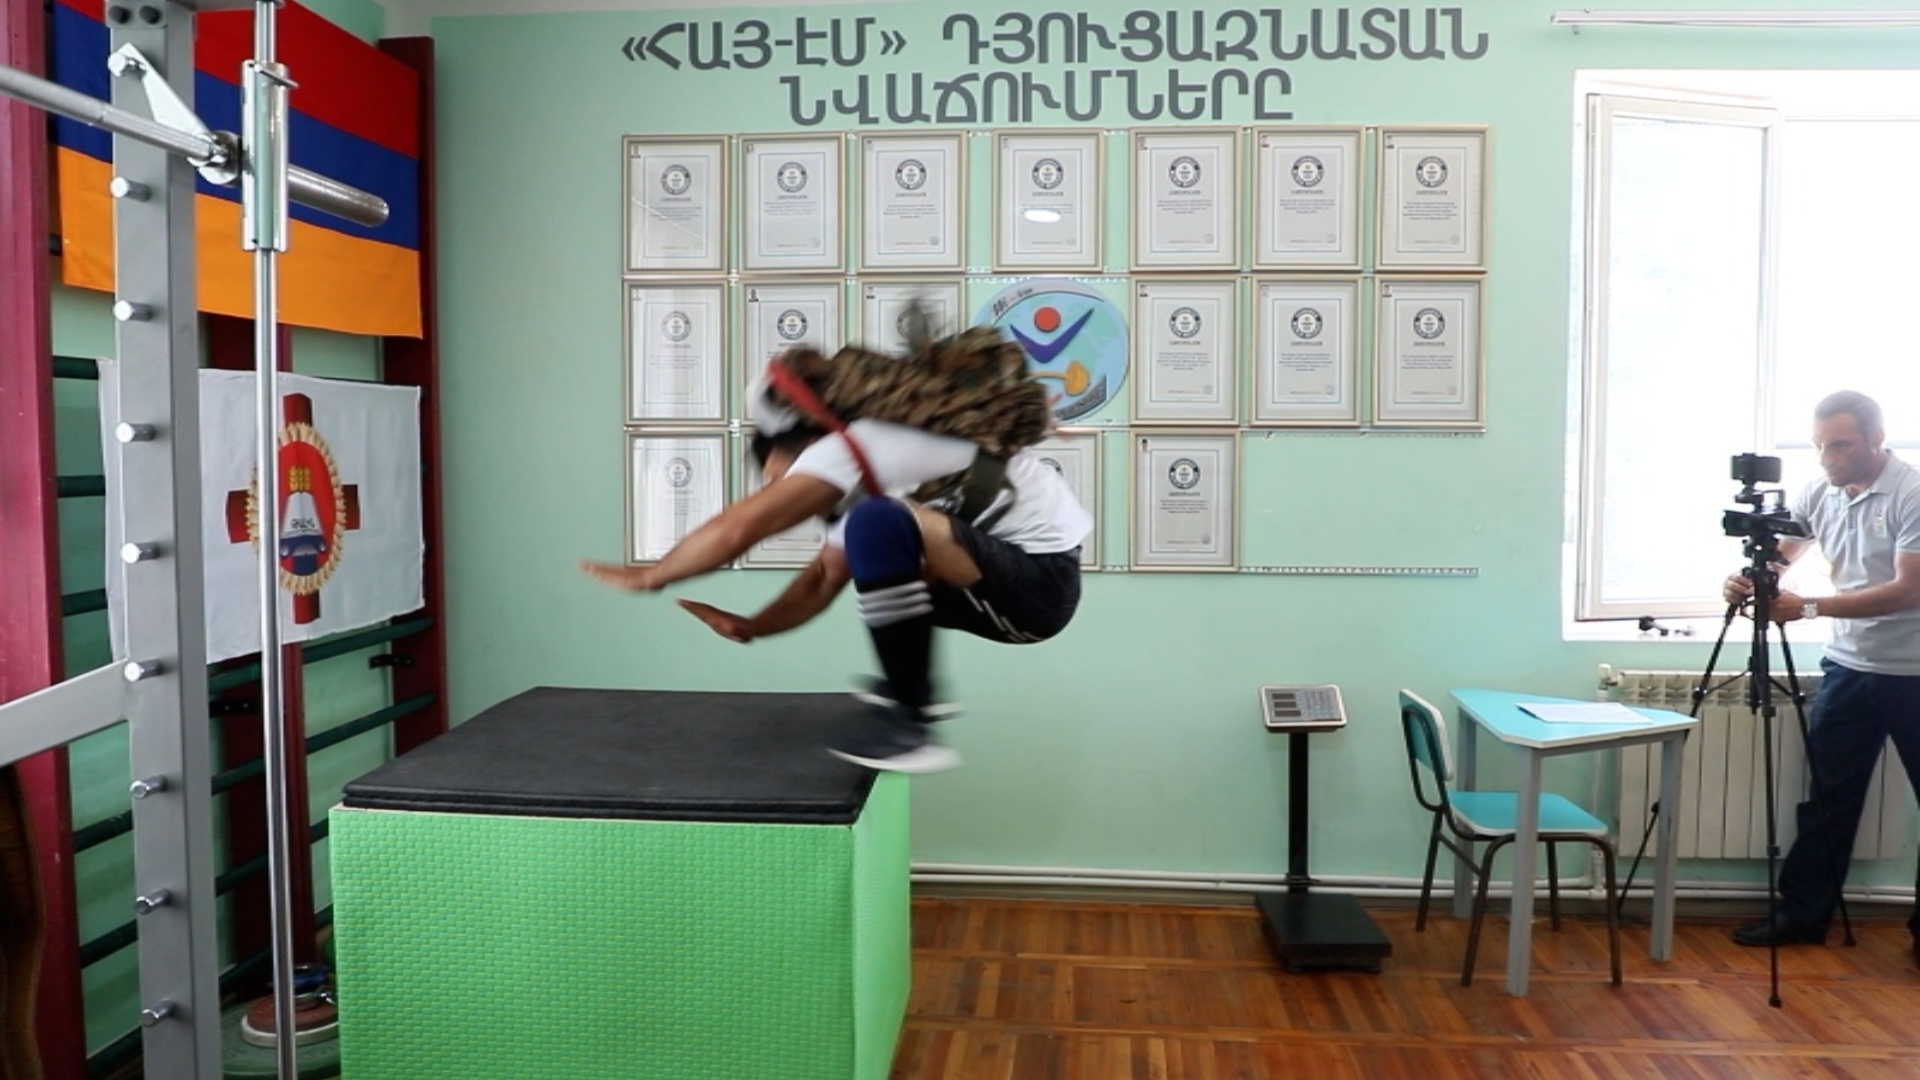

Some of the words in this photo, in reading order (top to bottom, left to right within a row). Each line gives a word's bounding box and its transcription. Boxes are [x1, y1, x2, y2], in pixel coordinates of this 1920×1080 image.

[620, 17, 907, 70] «ՀԱՅ-ԷՄ»
[942, 8, 1489, 64] ԴՅՈՒՑԱԶՆԱՏԱՆ
[779, 69, 1294, 126] ՆՎԱՃՈՒՄՆԵՐԸ
